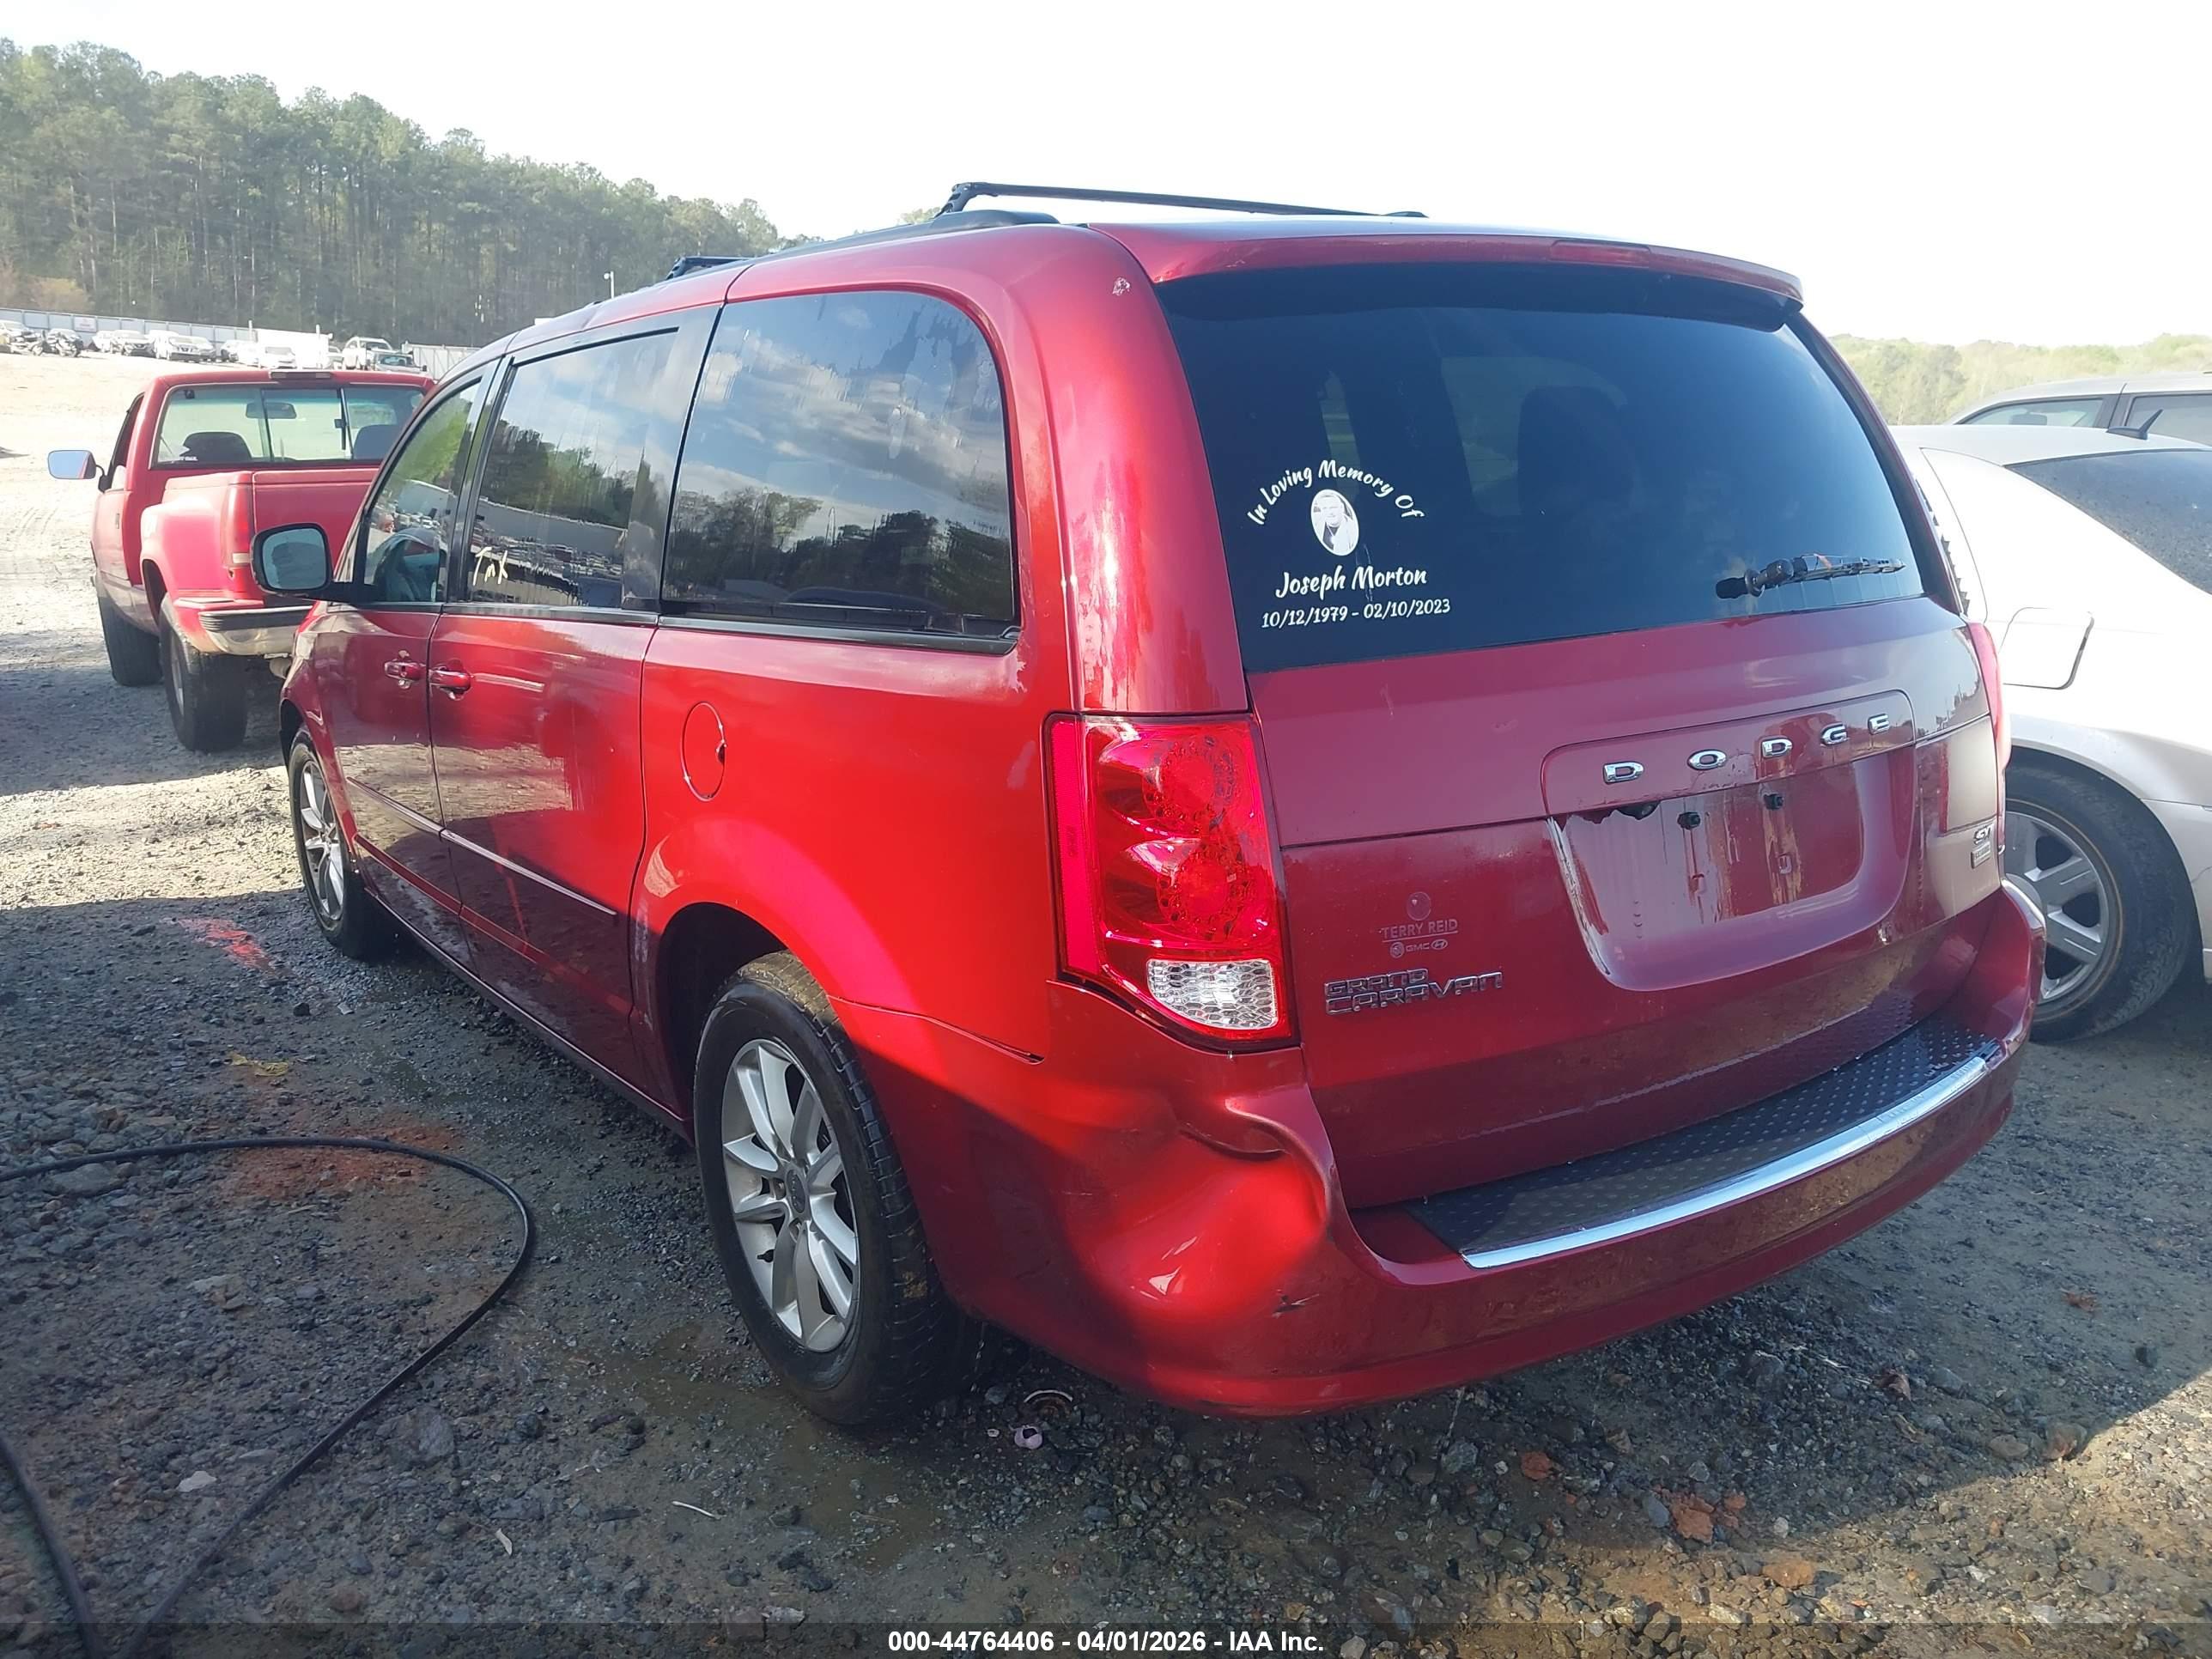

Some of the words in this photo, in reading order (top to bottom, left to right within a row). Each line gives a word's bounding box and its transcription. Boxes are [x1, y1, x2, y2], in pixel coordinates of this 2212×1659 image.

[1247, 504, 1267, 525] In
[1260, 467, 1313, 505] Loving
[1318, 459, 1395, 497] Memory
[1395, 495, 1425, 518] Of
[1275, 565, 1346, 600] Joseph
[1352, 565, 1427, 590] Morton
[1261, 606, 1347, 629] 10/12/1979
[1364, 599, 1450, 620] 02/10/2023
[1602, 713, 1890, 784] DODGE
[1382, 922, 1424, 939] TERRY
[1428, 918, 1458, 933] REID
[1406, 942, 1430, 952] GMC
[1325, 969, 1428, 997] GRAND
[1326, 971, 1503, 1015] CARAVAN
